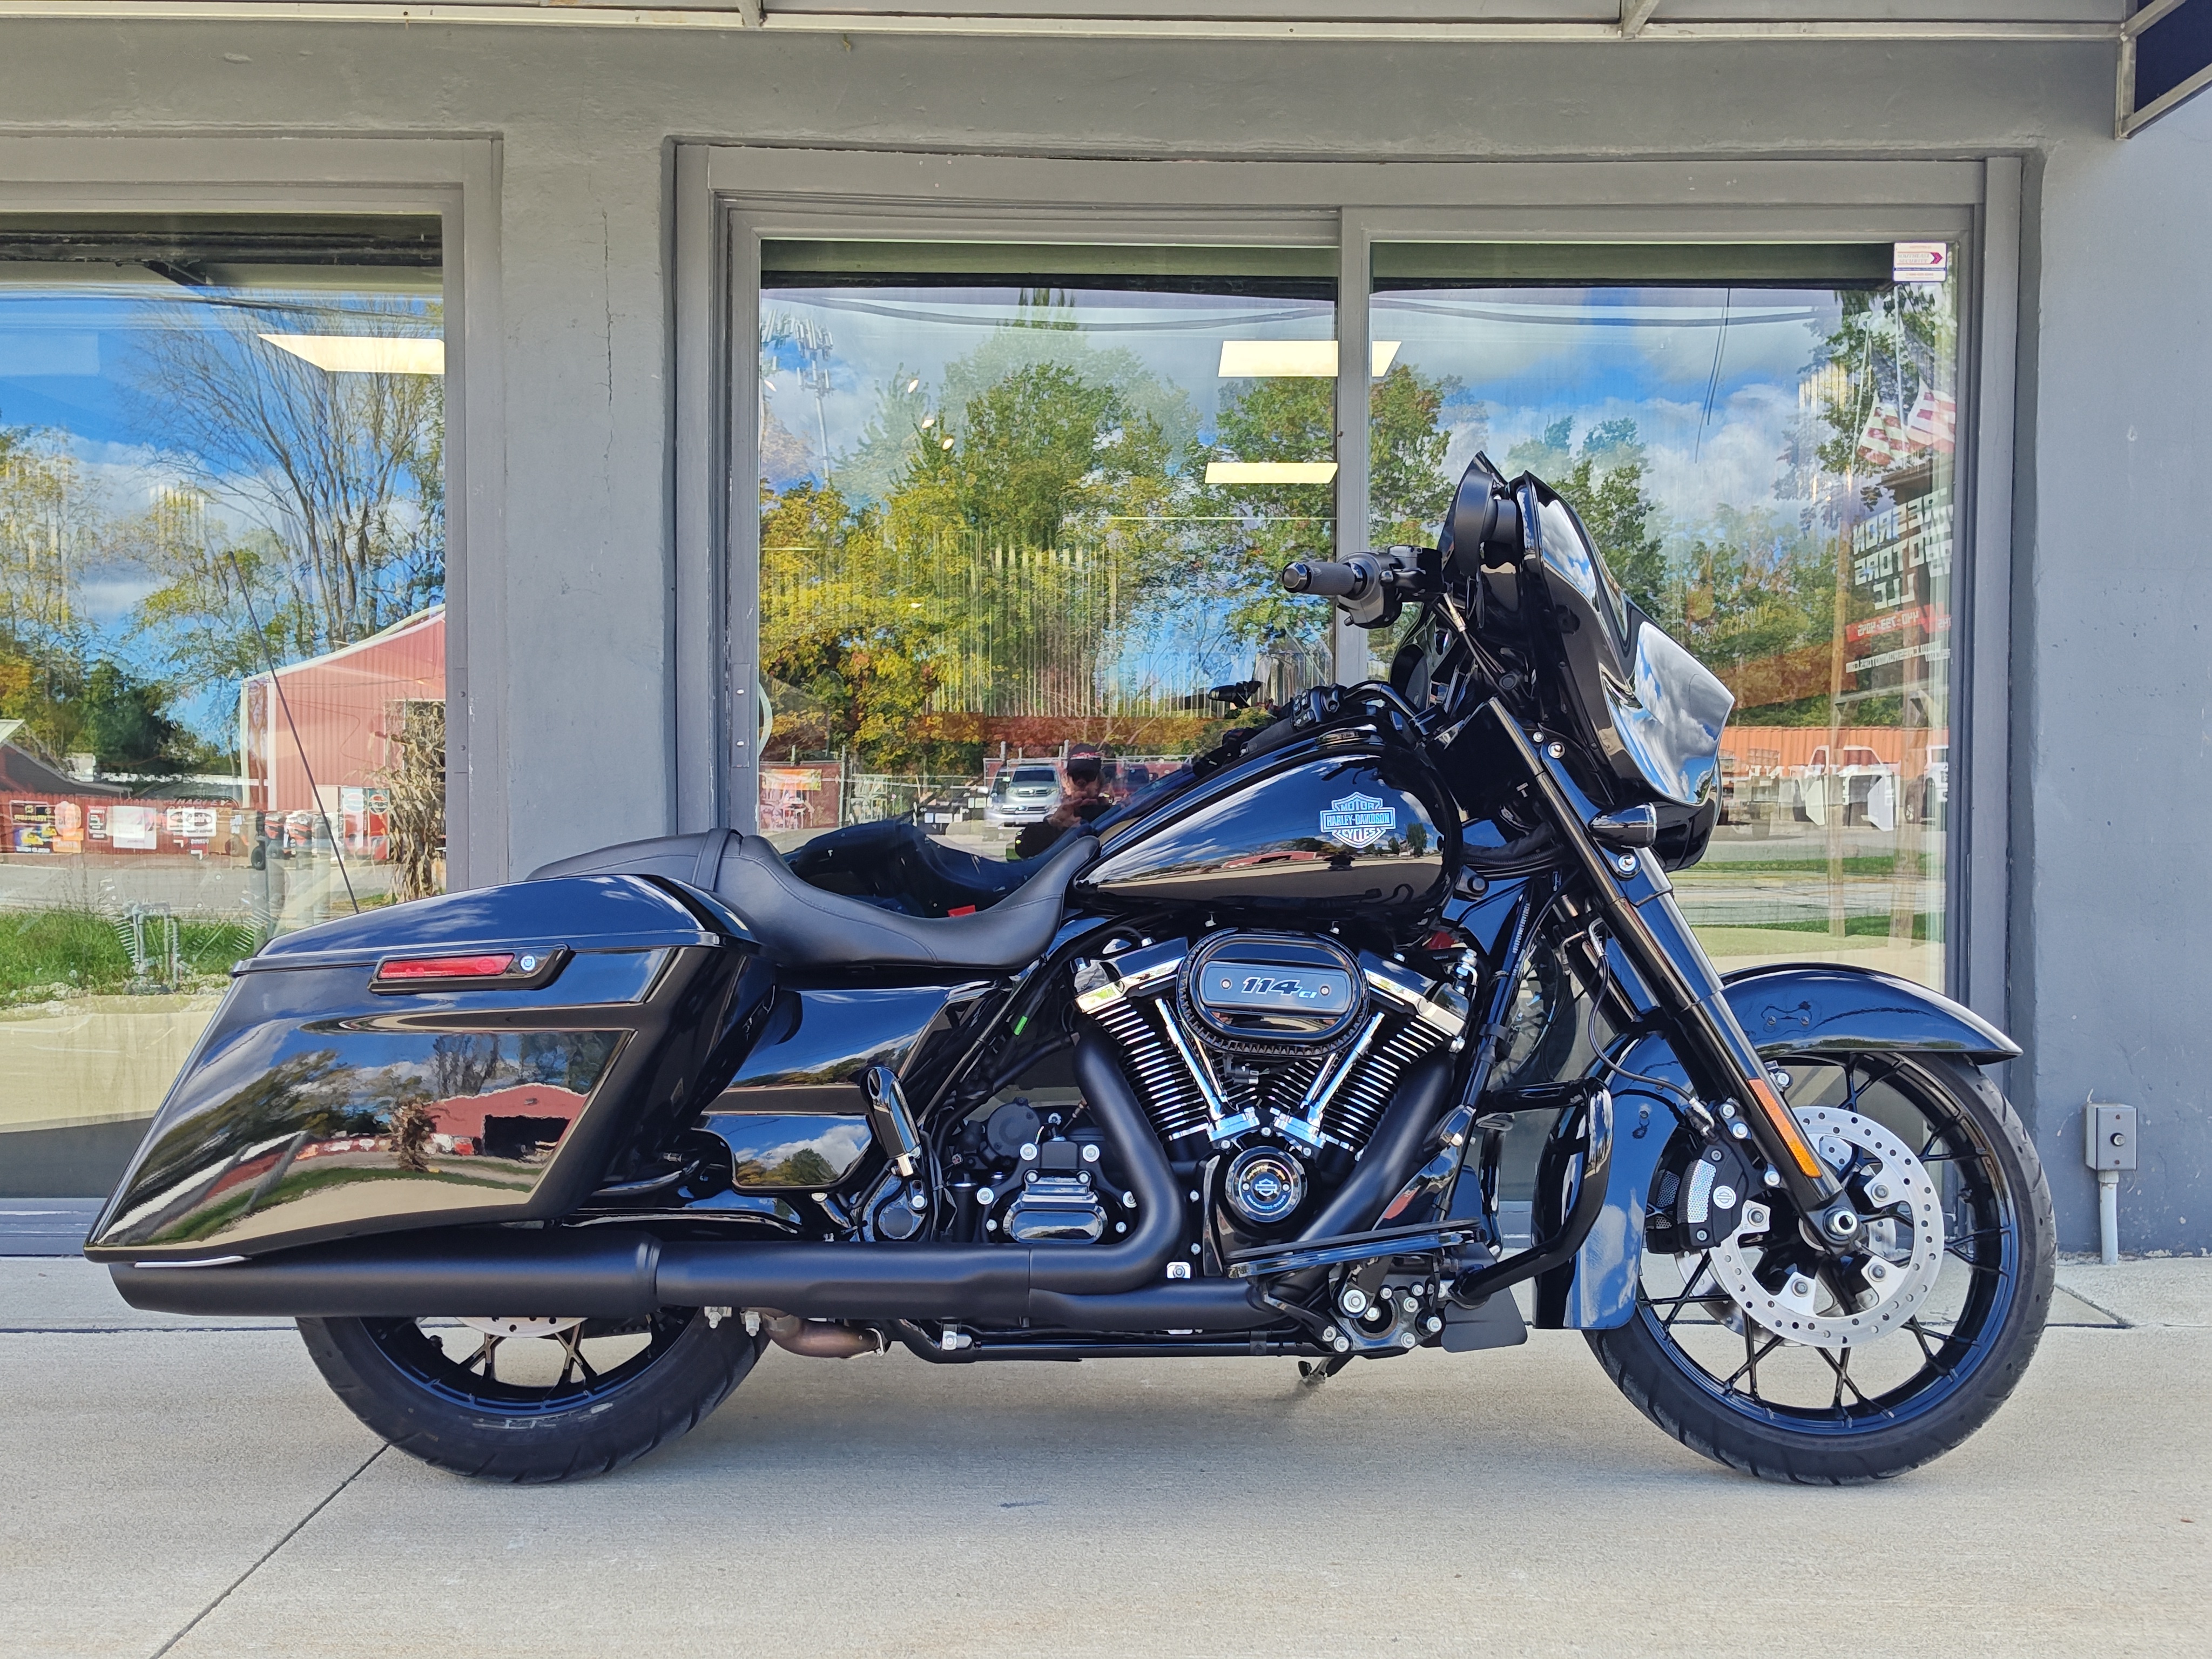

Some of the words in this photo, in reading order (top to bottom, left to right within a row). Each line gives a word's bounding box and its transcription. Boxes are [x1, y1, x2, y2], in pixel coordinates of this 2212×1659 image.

[1340, 797, 1375, 811] MOTOR
[1327, 813, 1390, 827] HARLEY-DAVIDSON
[1341, 827, 1376, 842] CYCLES
[1241, 977, 1303, 996] 114
